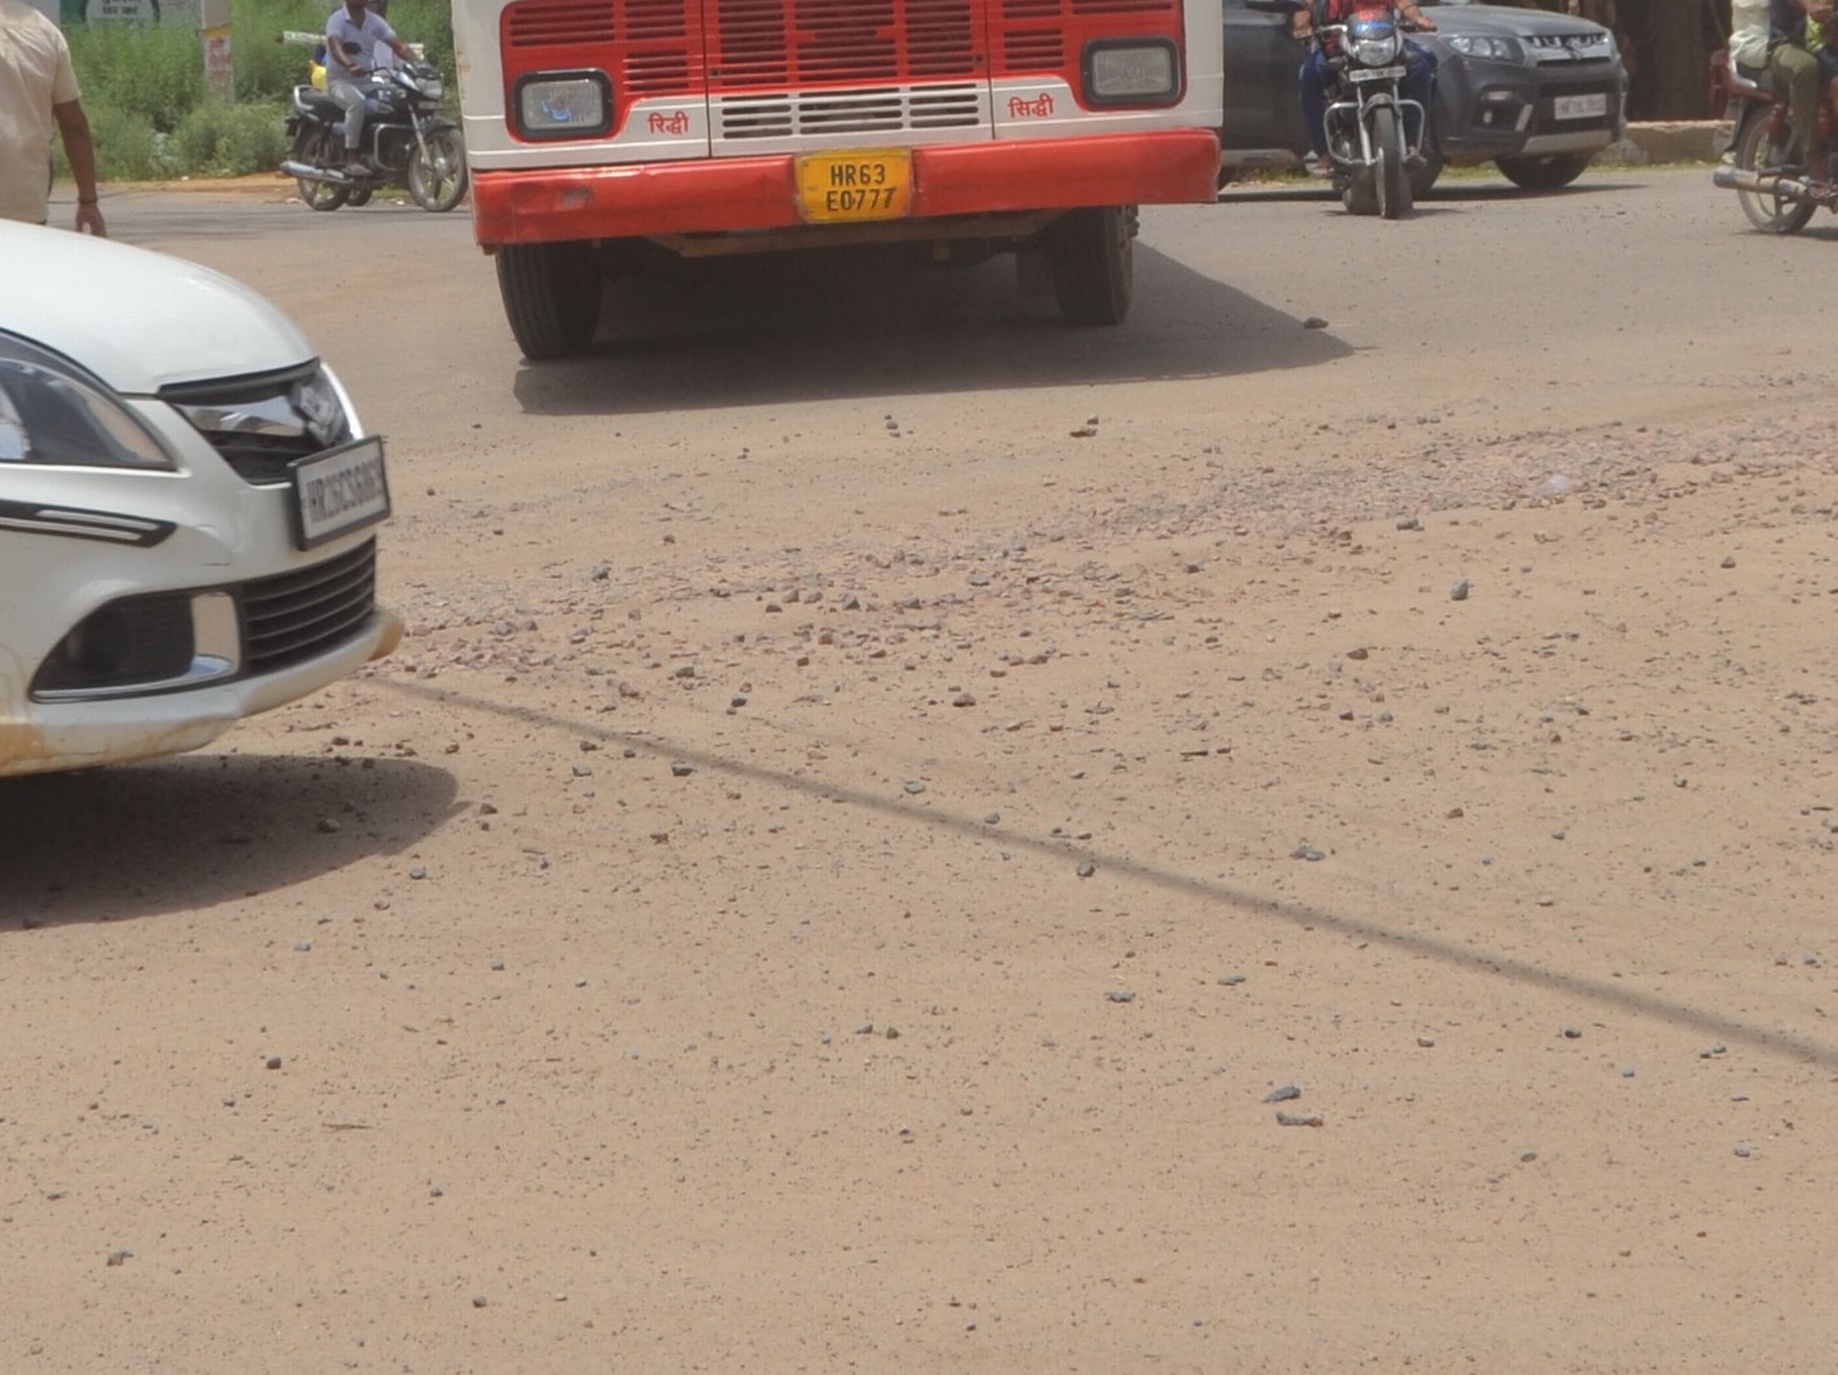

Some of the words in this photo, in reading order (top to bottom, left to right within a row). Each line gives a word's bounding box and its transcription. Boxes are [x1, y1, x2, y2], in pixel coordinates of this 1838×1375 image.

[1007, 92, 1055, 119] सिद्धी
[830, 162, 886, 187] HR63
[826, 186, 898, 212] E0777
